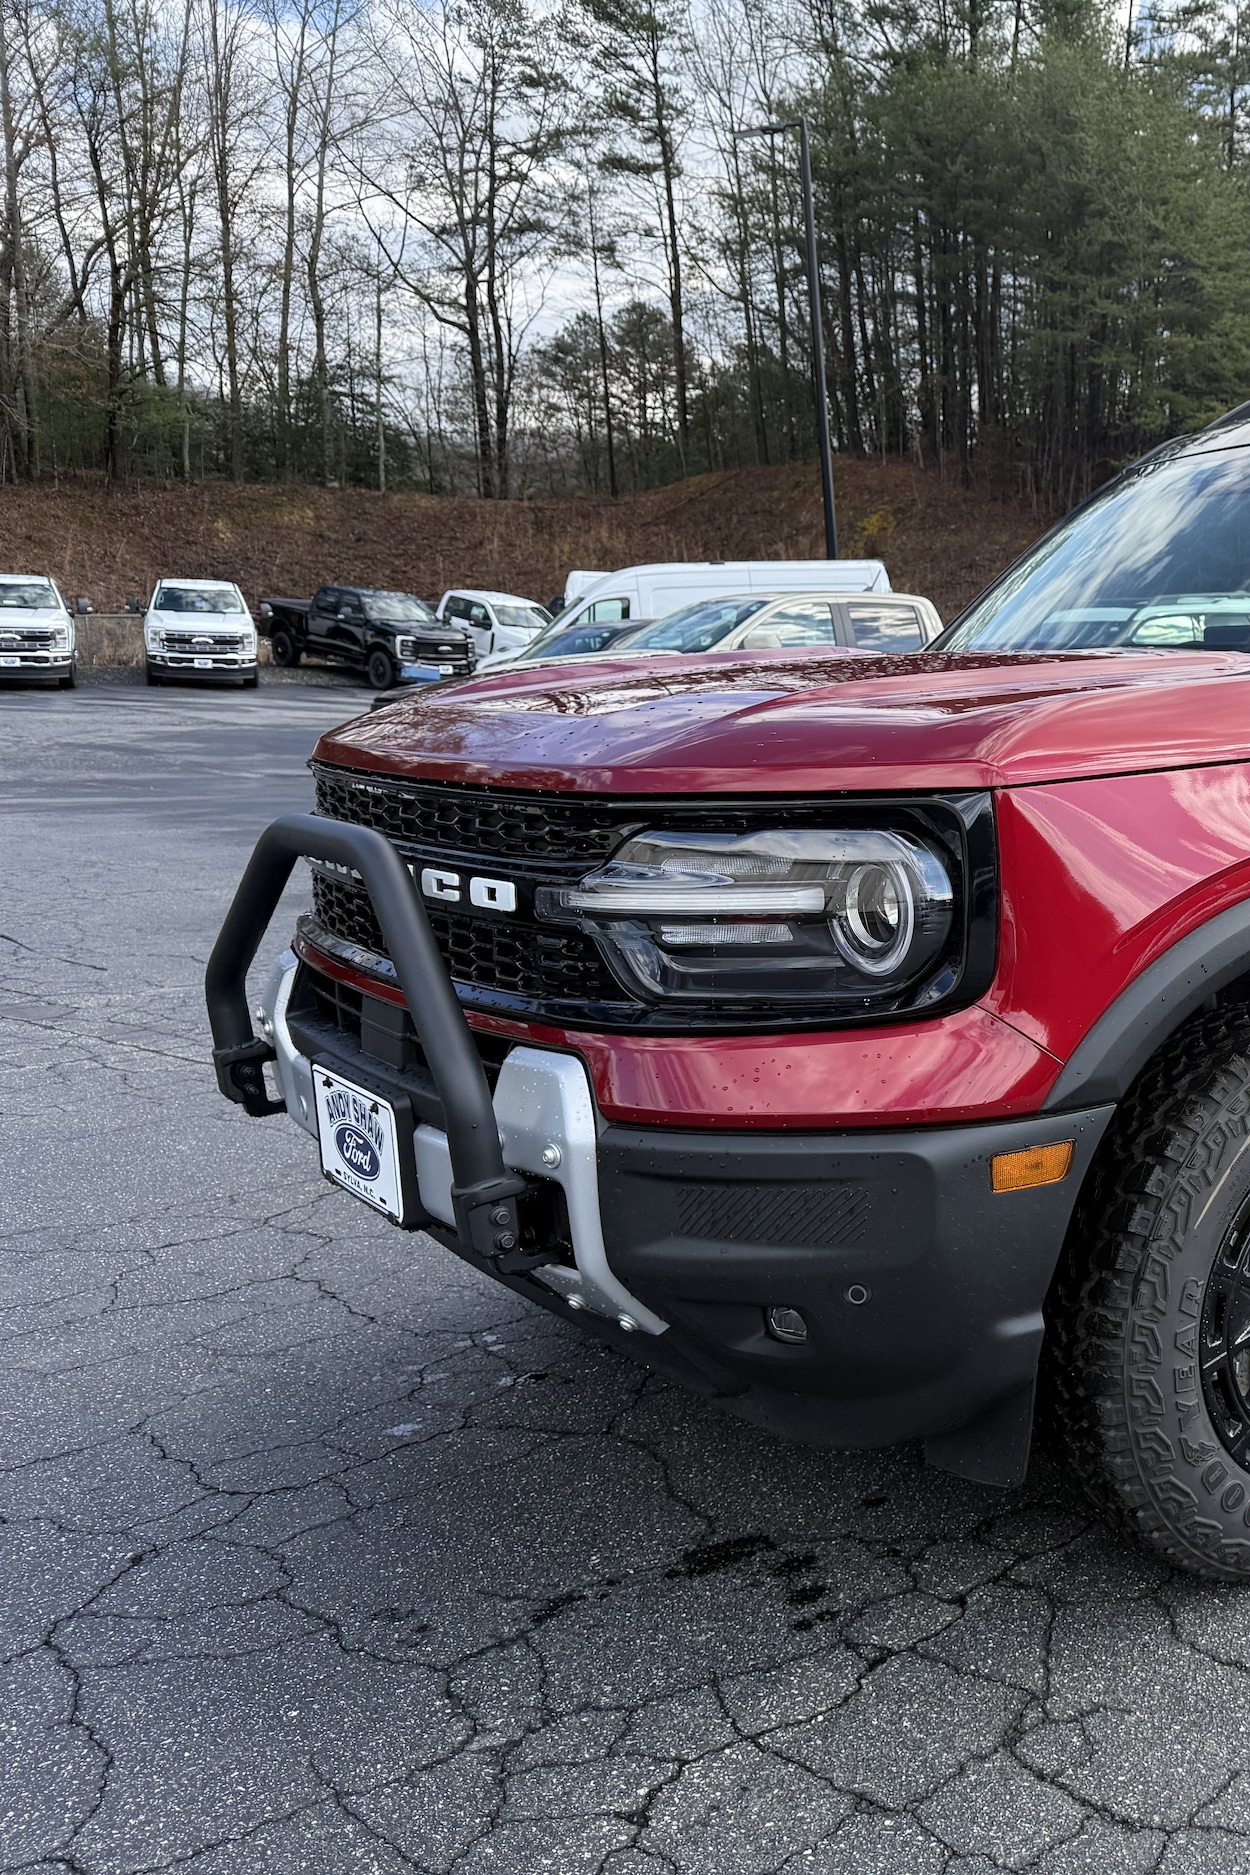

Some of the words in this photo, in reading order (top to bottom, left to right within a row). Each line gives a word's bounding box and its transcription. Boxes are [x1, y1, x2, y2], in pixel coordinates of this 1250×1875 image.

[325, 1089, 353, 1127] ANDY
[352, 1096, 385, 1156] SHAW
[343, 1130, 372, 1172] Ford
[343, 1171, 363, 1192] SYLVA,
